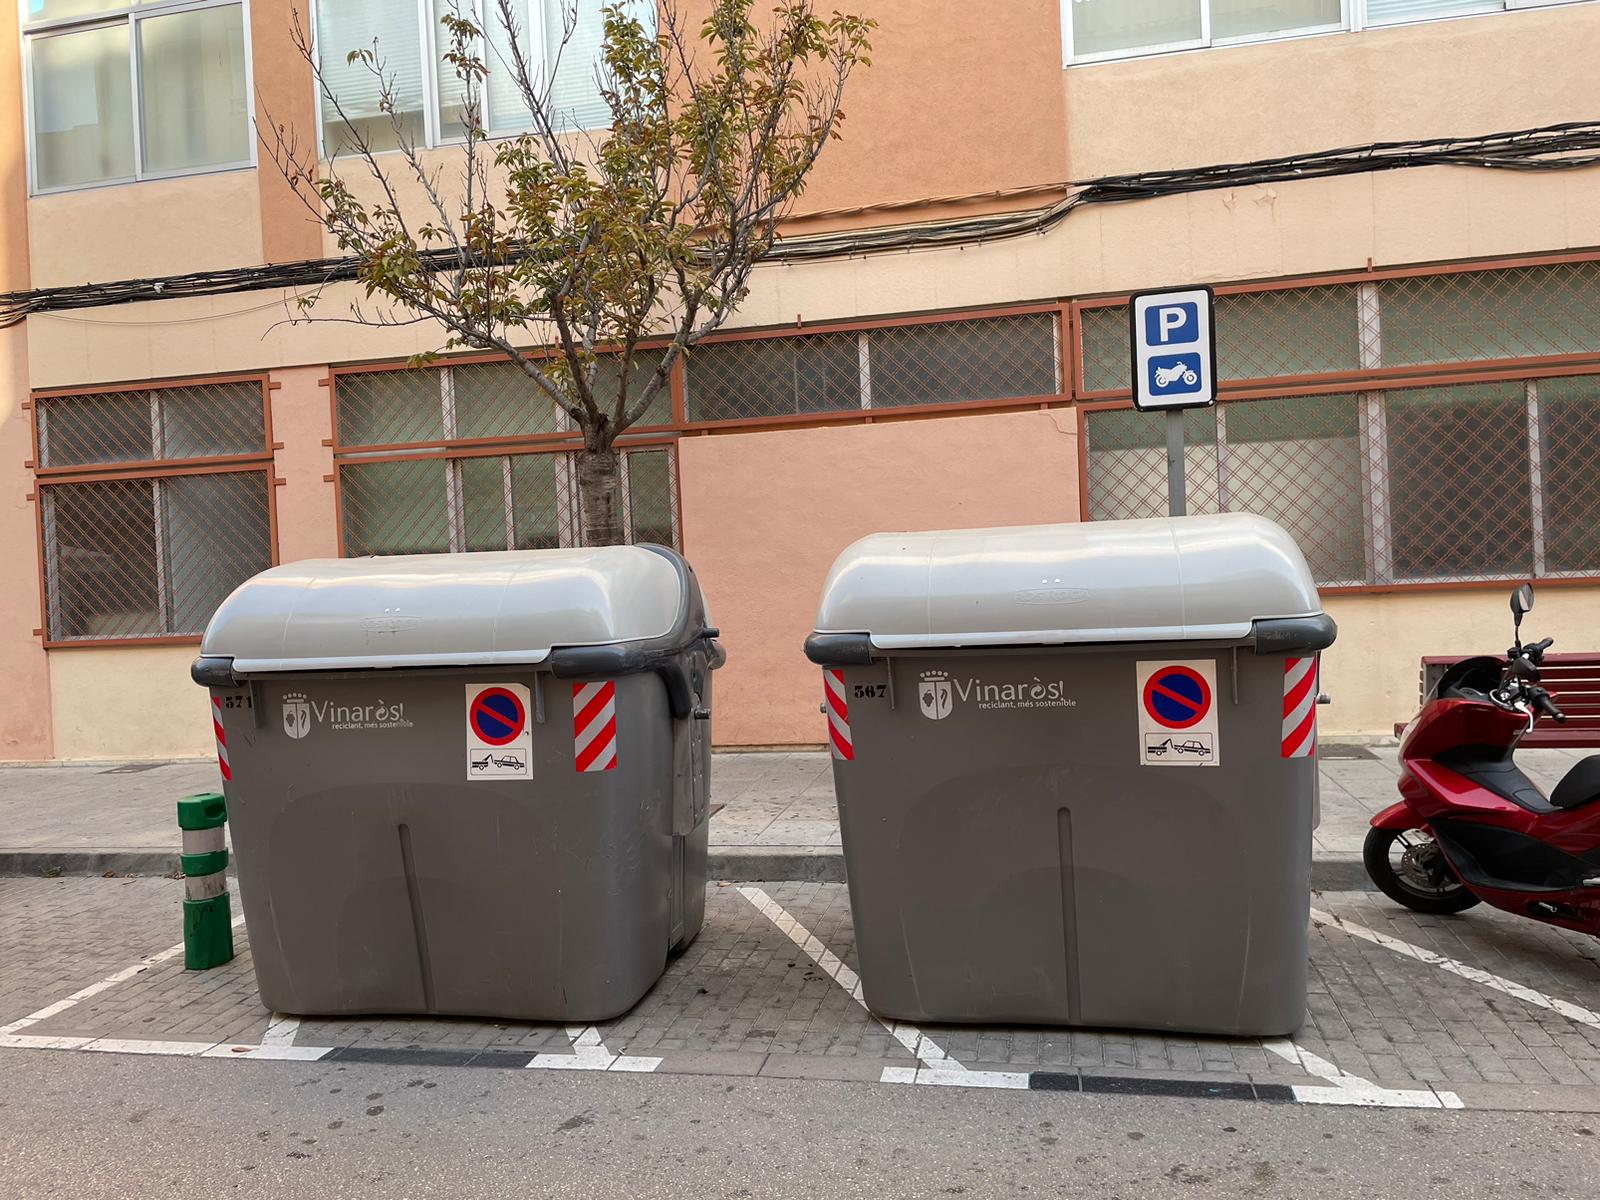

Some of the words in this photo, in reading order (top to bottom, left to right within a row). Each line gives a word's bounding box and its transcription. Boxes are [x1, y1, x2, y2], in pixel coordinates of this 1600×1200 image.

[1160, 307, 1187, 342] P
[953, 676, 1064, 702] Vinaròs!
[978, 700, 1017, 710] reciclant,
[1018, 699, 1034, 709] més
[1035, 698, 1077, 708] sostenible
